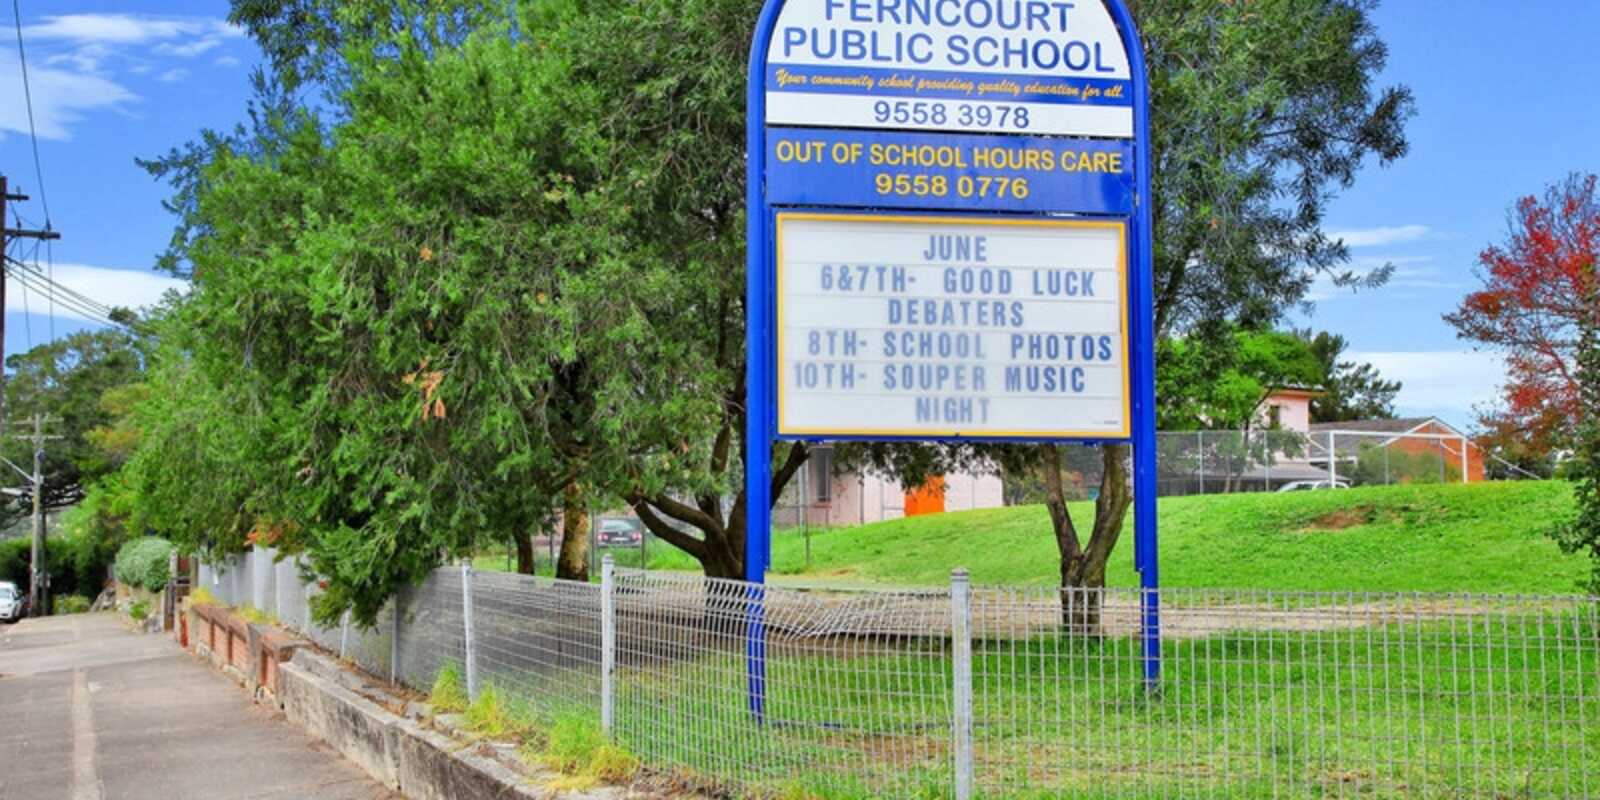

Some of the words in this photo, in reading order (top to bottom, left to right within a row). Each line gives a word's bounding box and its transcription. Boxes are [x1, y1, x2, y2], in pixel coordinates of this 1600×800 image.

[825, 0, 1075, 32] FERNCOURT
[783, 27, 934, 64] PUBLIC
[946, 35, 1115, 73] SCHOOL
[776, 69, 807, 88] Your
[811, 75, 874, 91] community
[878, 74, 914, 88] school
[916, 77, 974, 95] providing
[977, 79, 1021, 96] quality
[1023, 82, 1080, 96] education
[1081, 84, 1100, 101] for
[873, 101, 948, 125] 9558
[957, 105, 1030, 129] 3978
[775, 140, 826, 163] OUT
[831, 143, 863, 164] OF
[869, 144, 967, 168] SCHOOL
[973, 148, 1055, 171] HOURS
[1060, 150, 1123, 173] CARE
[874, 173, 949, 196] 9558
[957, 175, 1029, 199] 0776
[923, 235, 988, 262] JUNE
[820, 265, 917, 293] 6&7TH-
[943, 268, 1013, 295] GOOD
[1032, 271, 1096, 297] LUCK
[887, 301, 1024, 327] DEBATERS
[808, 330, 868, 357] 8TH-
[883, 331, 987, 359] SCHOOL
[1010, 334, 1113, 361] PHOTOS
[793, 363, 867, 389] 10TH-
[883, 363, 986, 391] SOUPER
[1004, 366, 1086, 393] MUSIC
[915, 397, 990, 424] NIGHT
